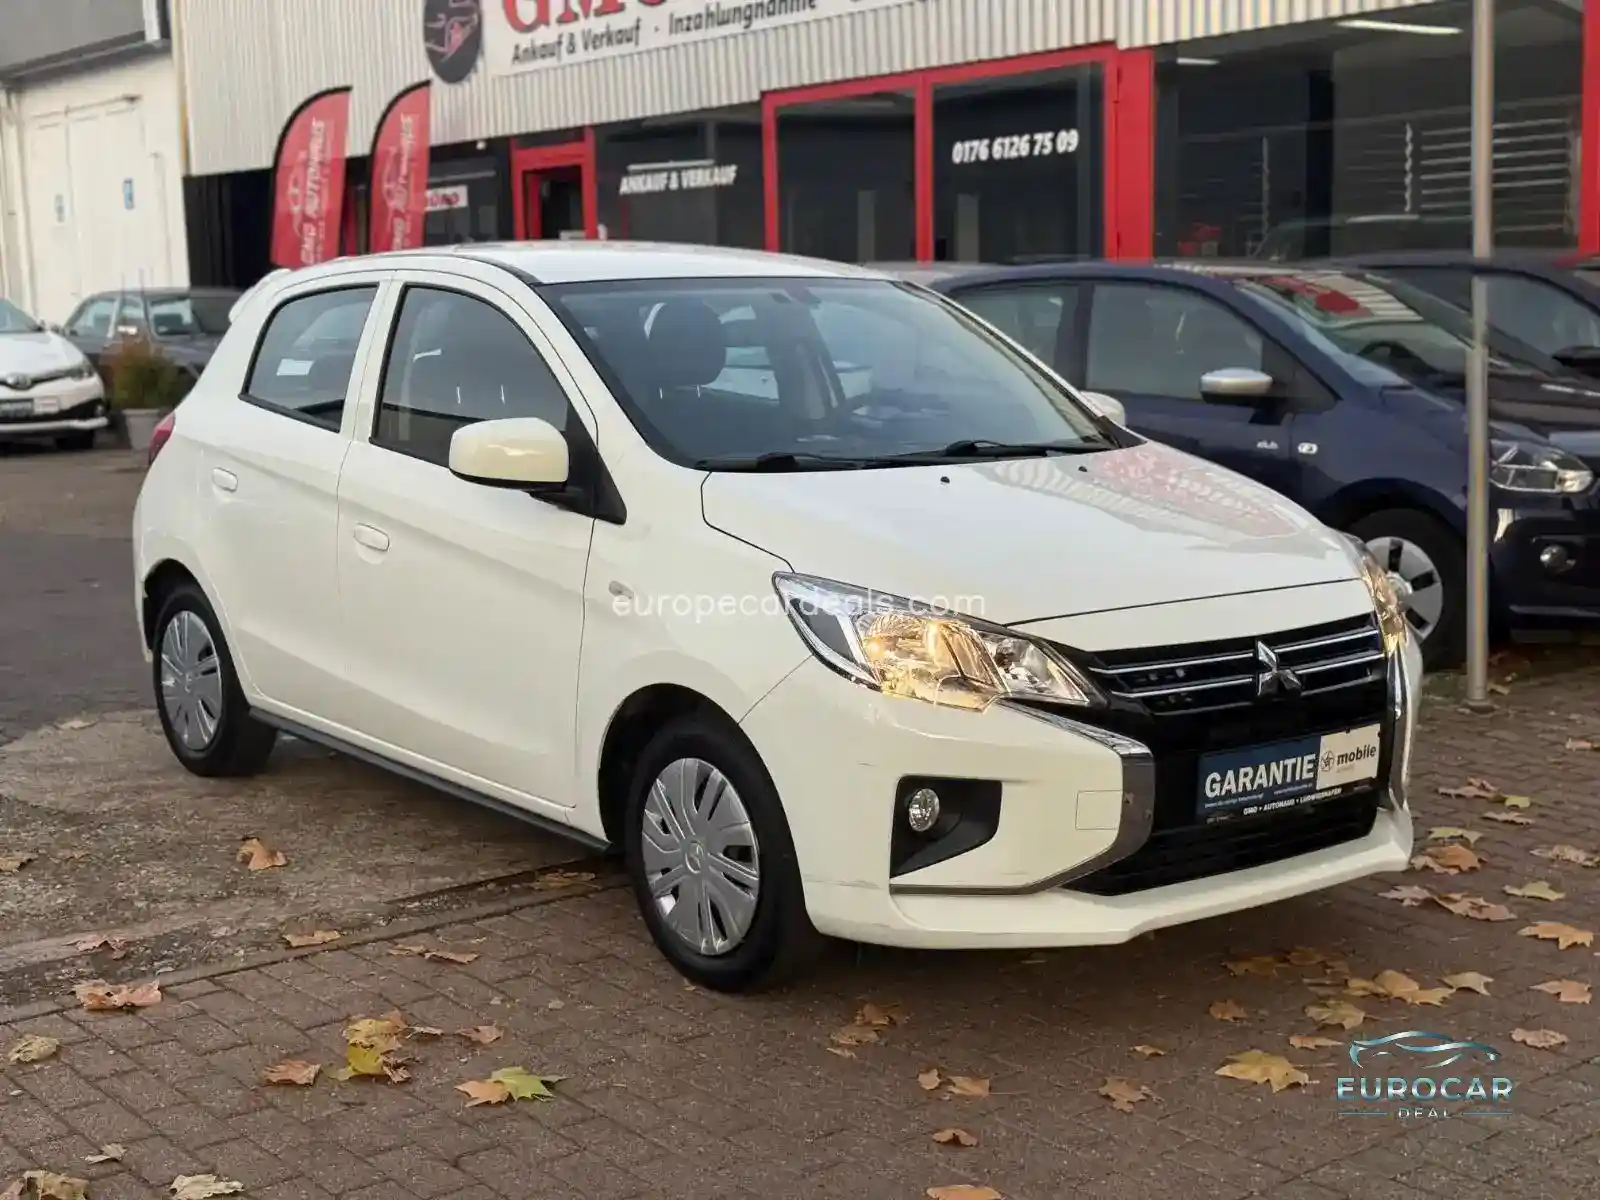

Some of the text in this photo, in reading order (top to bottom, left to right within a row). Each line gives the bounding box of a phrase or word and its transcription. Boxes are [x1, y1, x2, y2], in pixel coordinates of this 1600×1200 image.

[512, 33, 563, 64] Ankauf
[566, 32, 576, 55] &
[581, 17, 642, 51] Verkauf
[952, 129, 1079, 164] 0176 6126 75 09
[619, 164, 737, 195] ANKAUF & VERKAUF
[1336, 744, 1377, 766] mobile
[1204, 754, 1316, 798] GARANTIE
